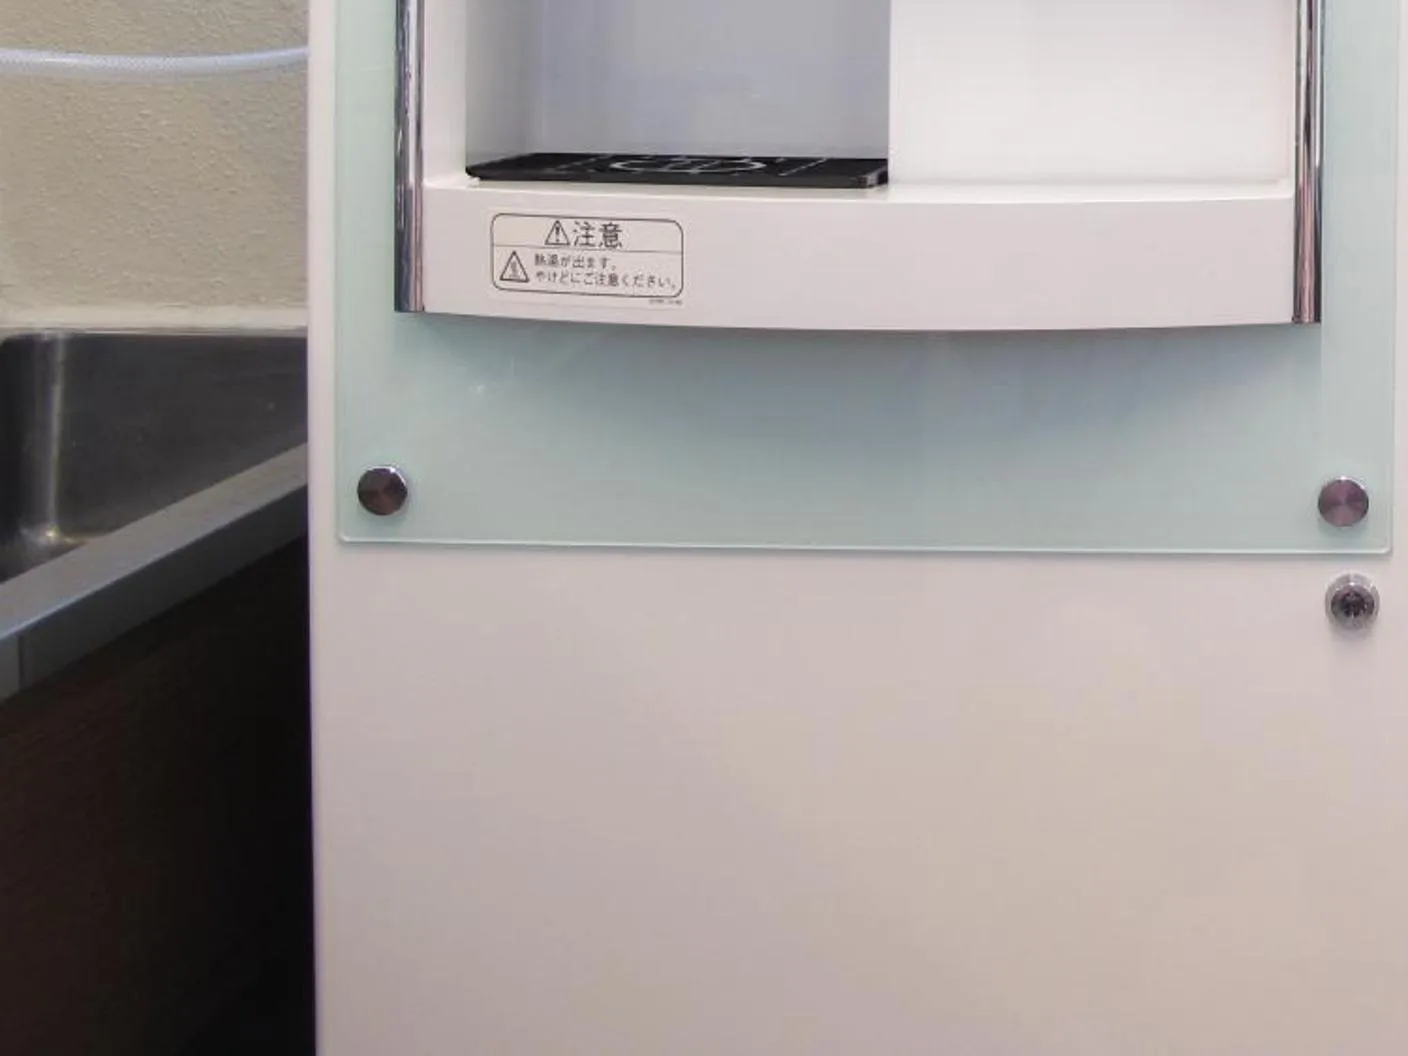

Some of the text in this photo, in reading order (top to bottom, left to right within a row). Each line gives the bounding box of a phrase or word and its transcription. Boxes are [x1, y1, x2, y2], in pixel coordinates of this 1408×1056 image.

[573, 221, 623, 249] 注意
[535, 271, 677, 289] やけどにご注意ください。
